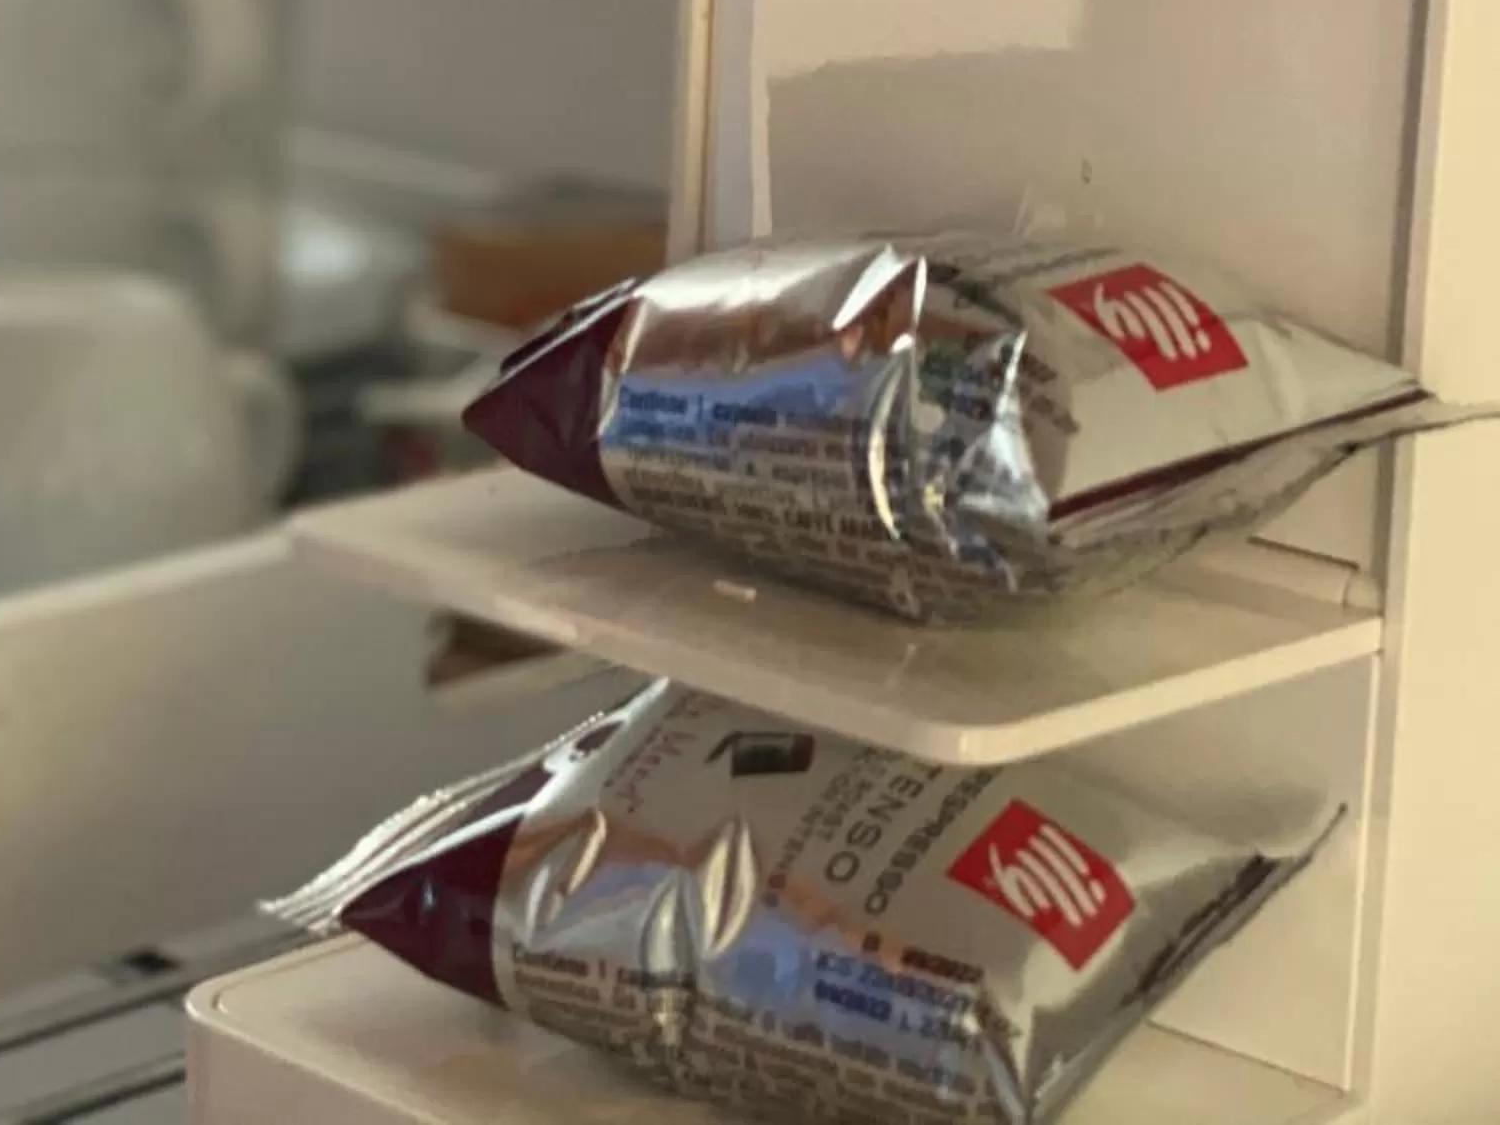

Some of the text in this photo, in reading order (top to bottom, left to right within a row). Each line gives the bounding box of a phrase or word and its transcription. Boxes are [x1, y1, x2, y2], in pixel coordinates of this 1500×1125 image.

[1091, 280, 1213, 363] illy
[824, 761, 944, 884] TENSO
[985, 820, 1108, 930] illy
